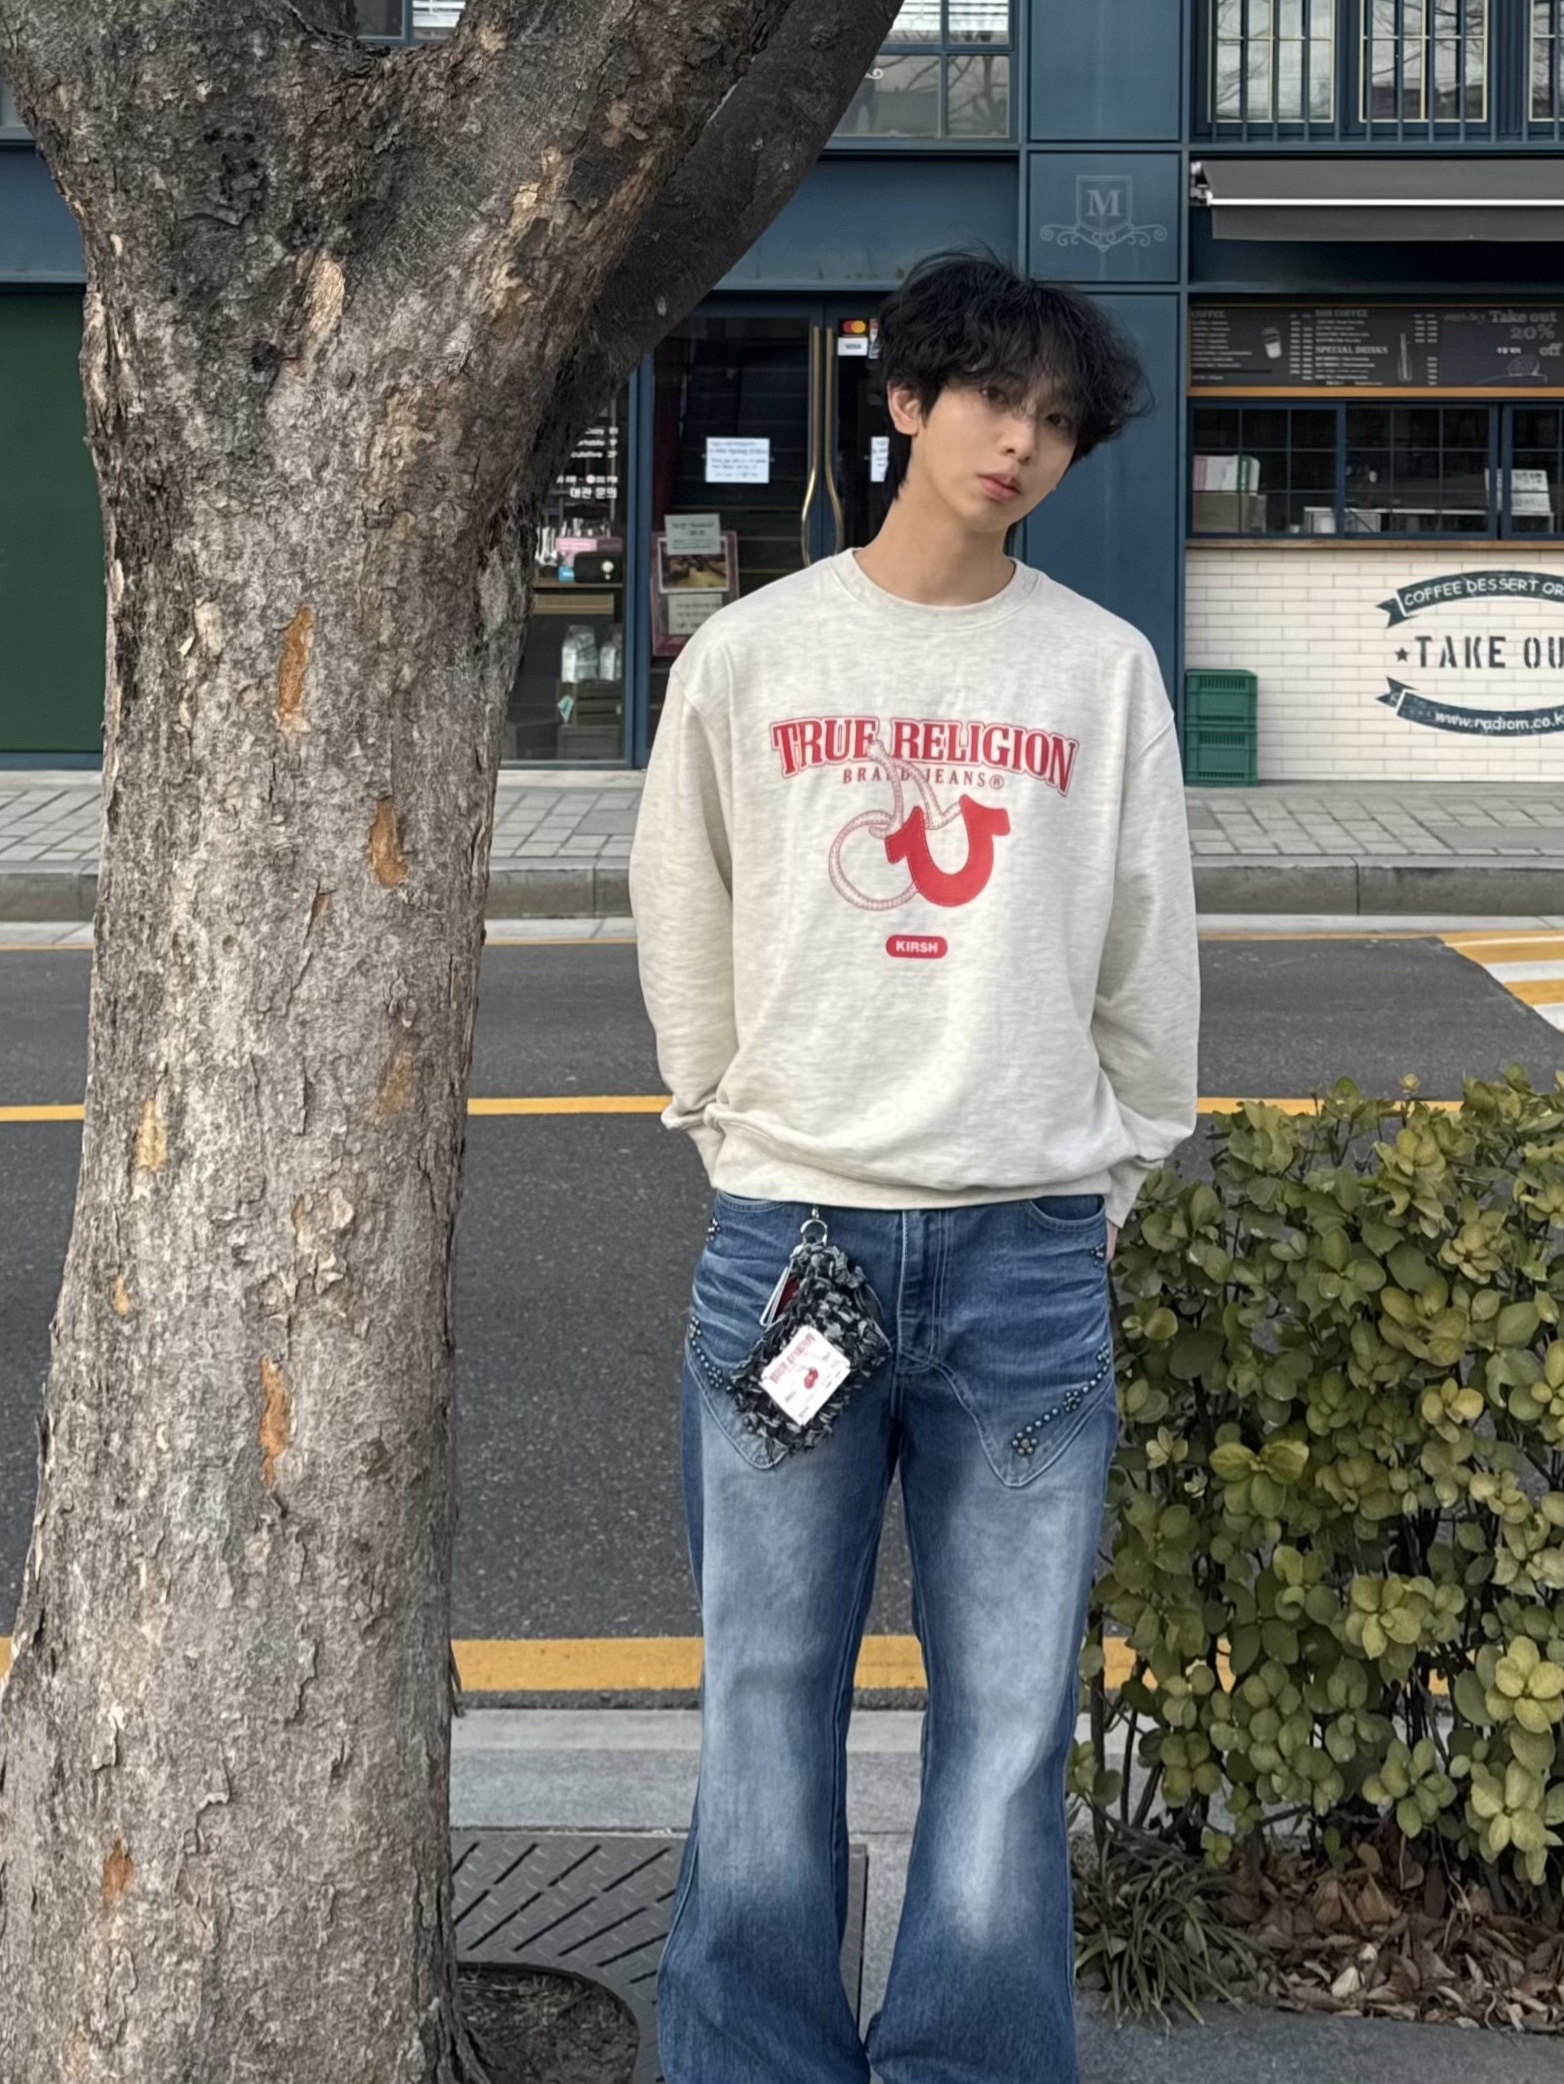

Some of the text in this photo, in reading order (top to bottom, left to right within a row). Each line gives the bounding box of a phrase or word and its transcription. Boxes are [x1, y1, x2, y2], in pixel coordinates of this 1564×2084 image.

[1086, 189, 1121, 217] M
[1489, 310, 1527, 323] Take
[1529, 311, 1557, 323] out
[1510, 324, 1555, 340] 20%
[1315, 346, 1389, 354] SPECIAL DRINKS
[1539, 343, 1563, 356] off
[1404, 581, 1463, 606] COFFEE
[1465, 577, 1540, 594] DESSERT
[1414, 635, 1507, 669] TAKE
[770, 716, 1080, 798] TRUE RELIGION
[895, 941, 938, 953] KIRSH
